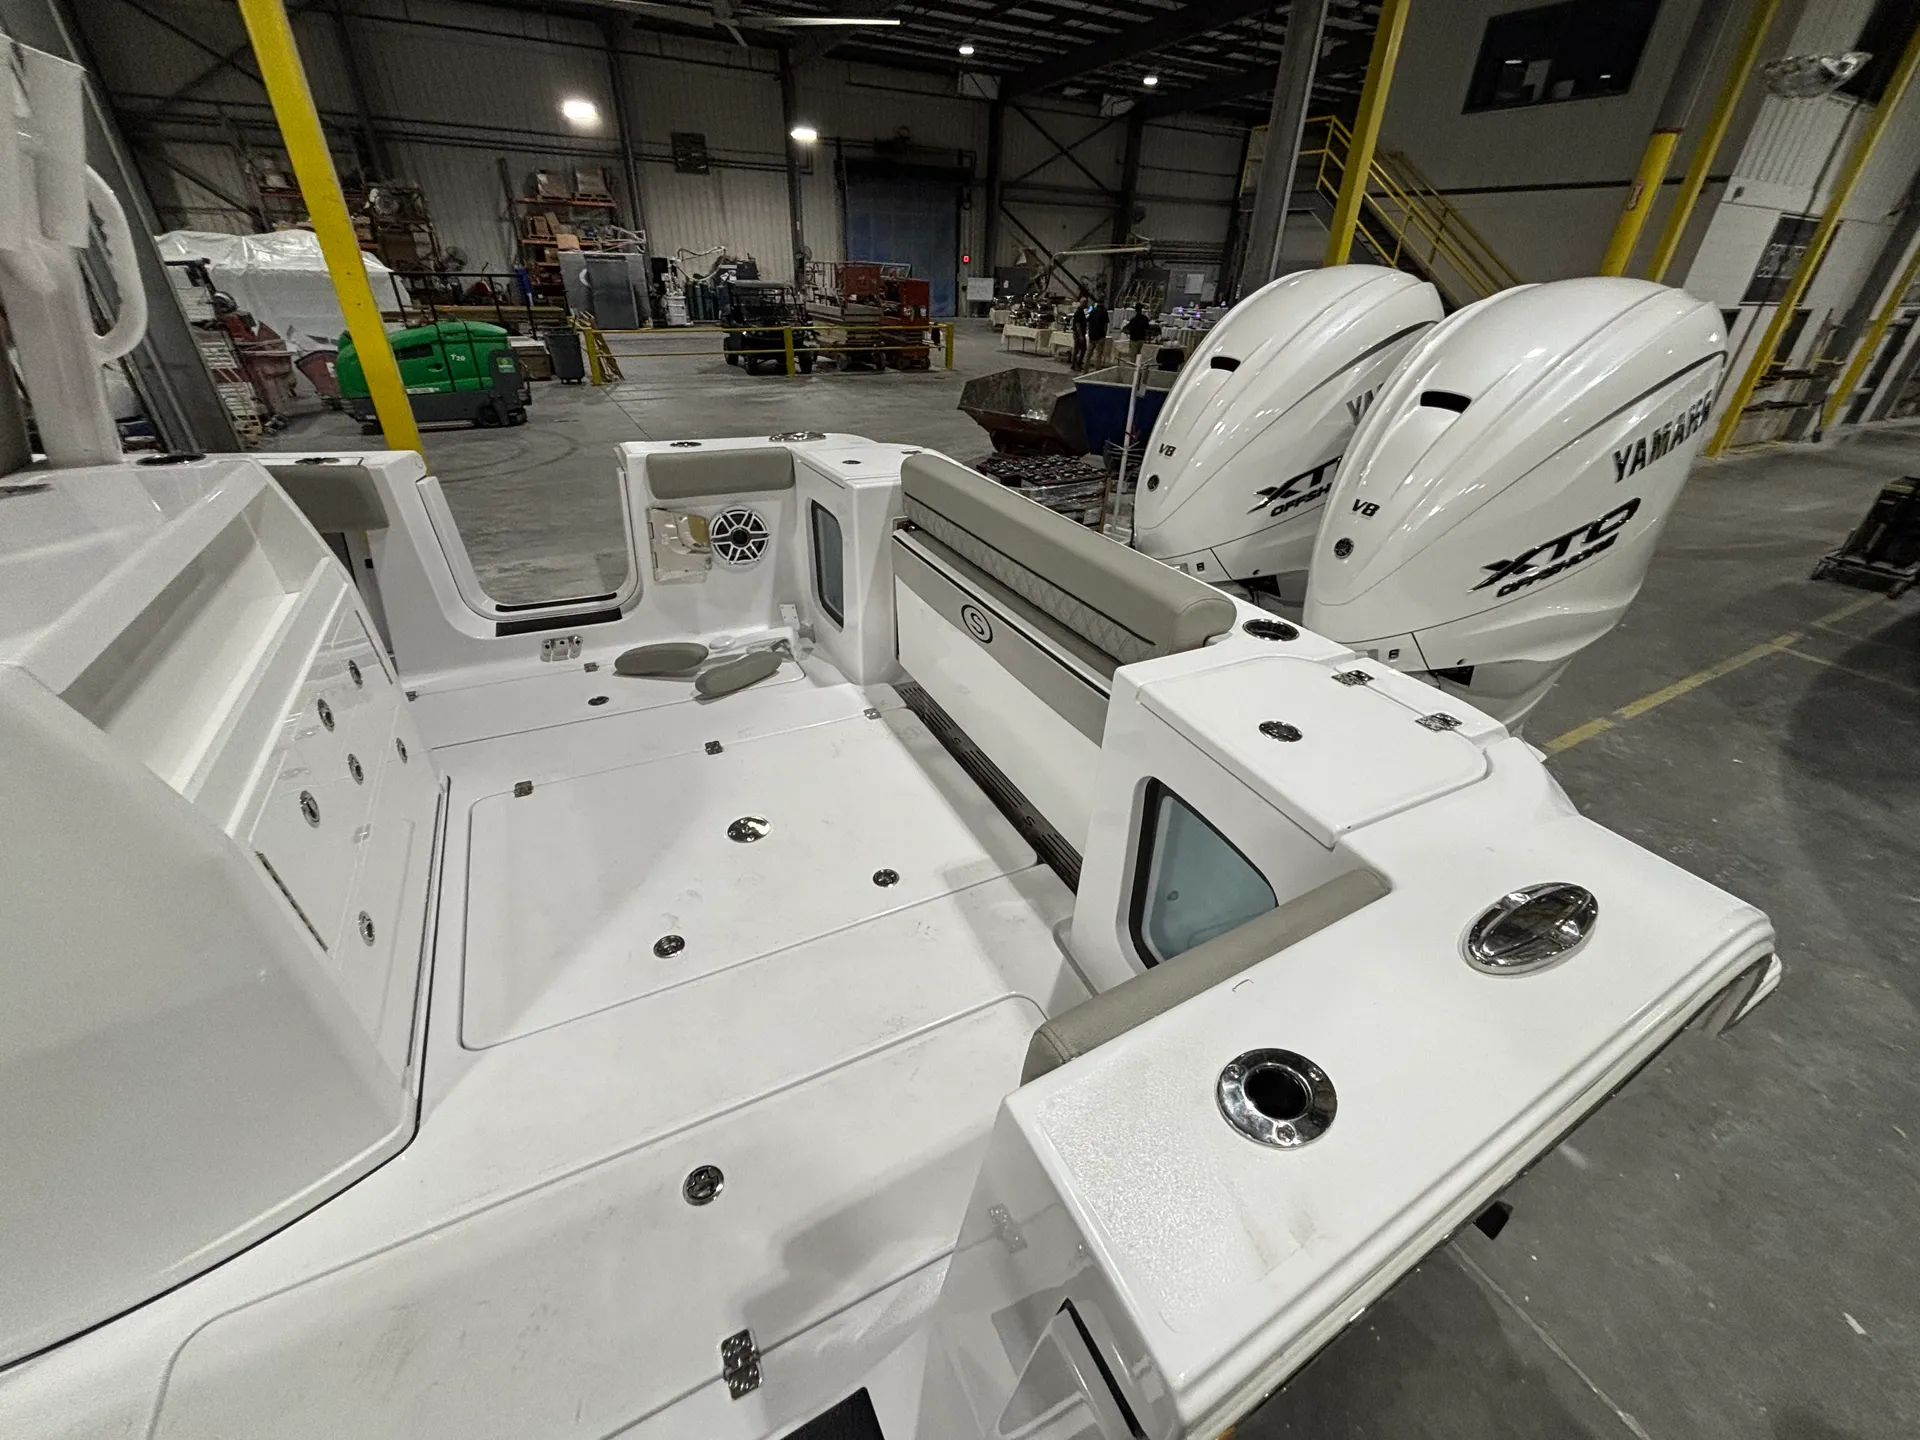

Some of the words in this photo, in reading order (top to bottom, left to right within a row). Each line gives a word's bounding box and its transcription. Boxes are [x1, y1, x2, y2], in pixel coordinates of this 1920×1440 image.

[450, 353, 466, 362] T20
[1158, 443, 1176, 457] V8
[1247, 455, 1343, 515] XT
[1270, 482, 1333, 517] OFFSH
[1352, 498, 1381, 517] V8
